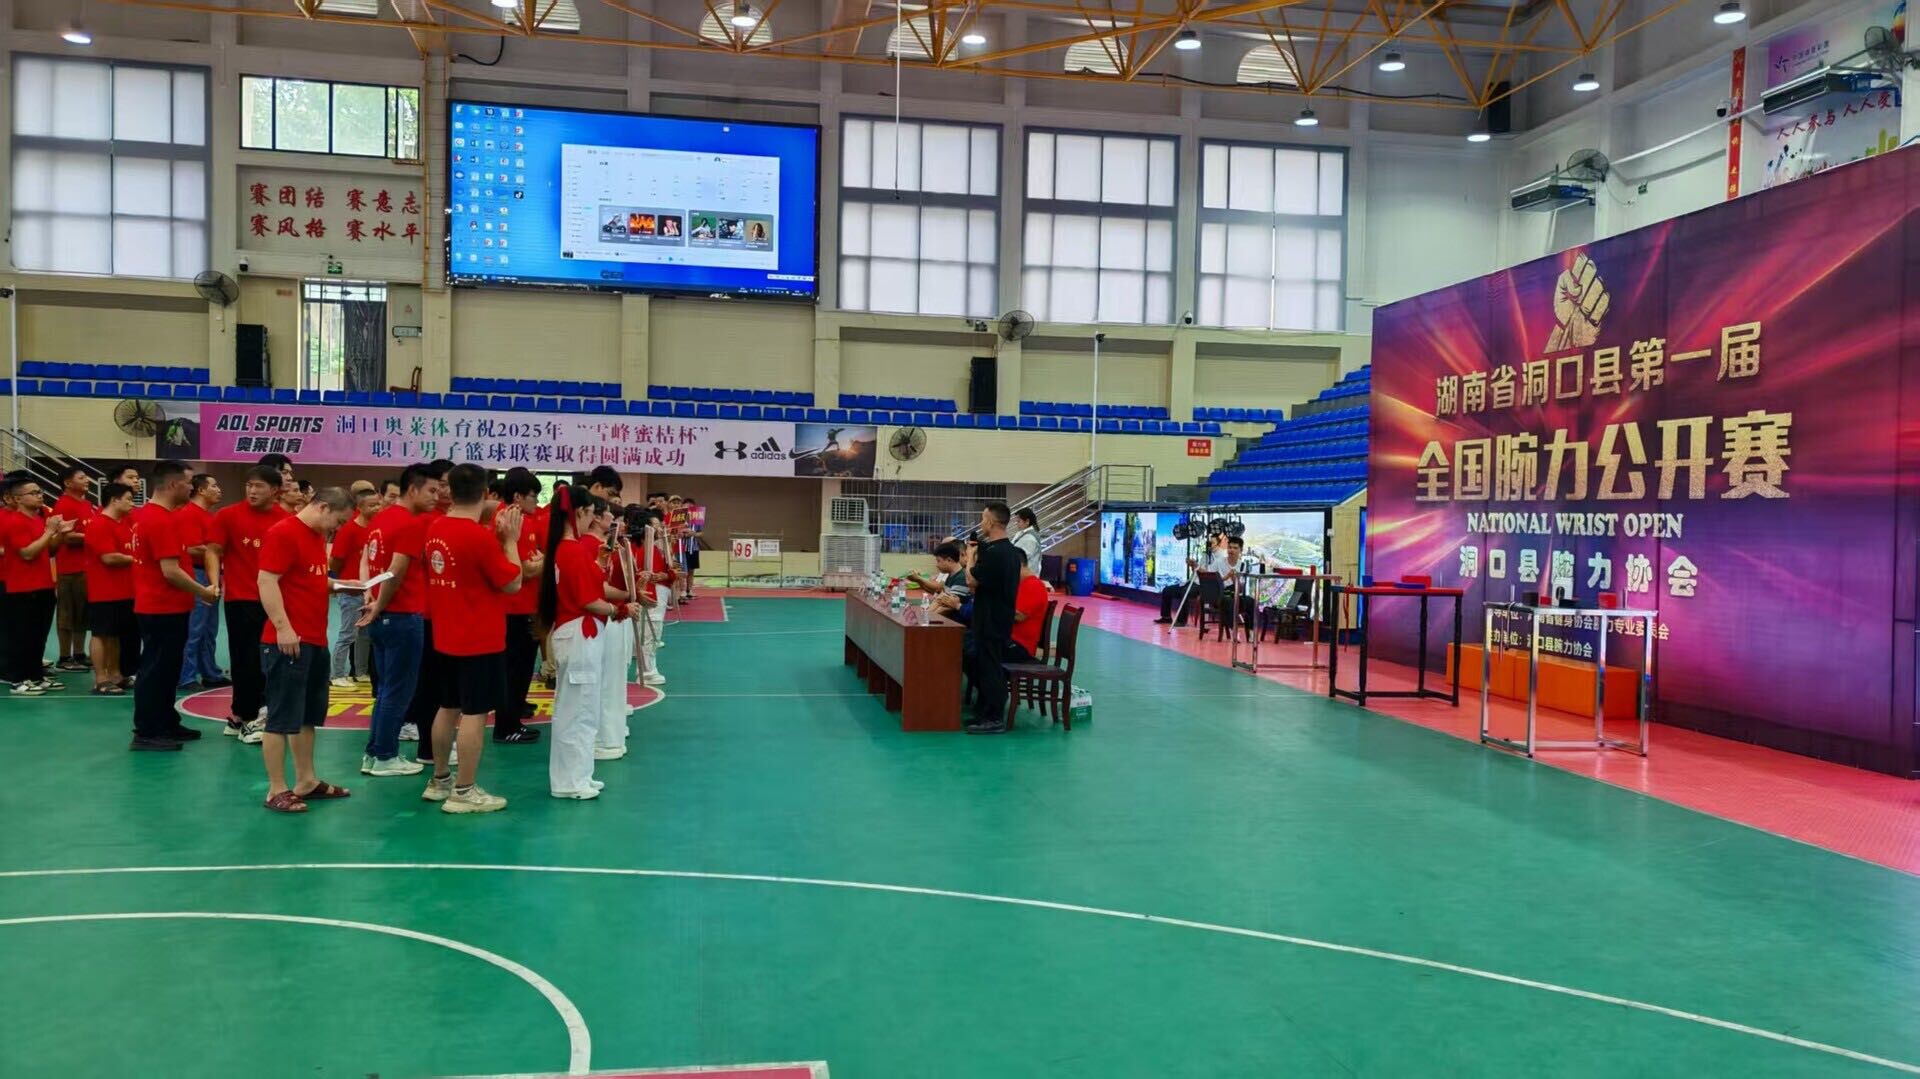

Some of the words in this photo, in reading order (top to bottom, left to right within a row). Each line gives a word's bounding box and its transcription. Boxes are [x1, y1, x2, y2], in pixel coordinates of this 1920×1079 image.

[250, 182, 325, 209] 赛团结
[346, 189, 421, 215] 赛意志
[250, 213, 327, 238] 赛风格
[346, 218, 421, 245] 赛水平
[1436, 321, 1762, 416] 湖南省洞口县第一届
[216, 414, 250, 431] AOL
[254, 415, 324, 433] SPORTS
[235, 436, 303, 454] 奥莱体育
[750, 450, 787, 460] adidas
[1415, 410, 1793, 501] 全国腕力公开赛
[1467, 512, 1551, 535] NATIONAL
[1554, 512, 1620, 537] WRIST
[1623, 512, 1684, 539] OPEN
[1459, 545, 1698, 597] 洞口县腕力协会
